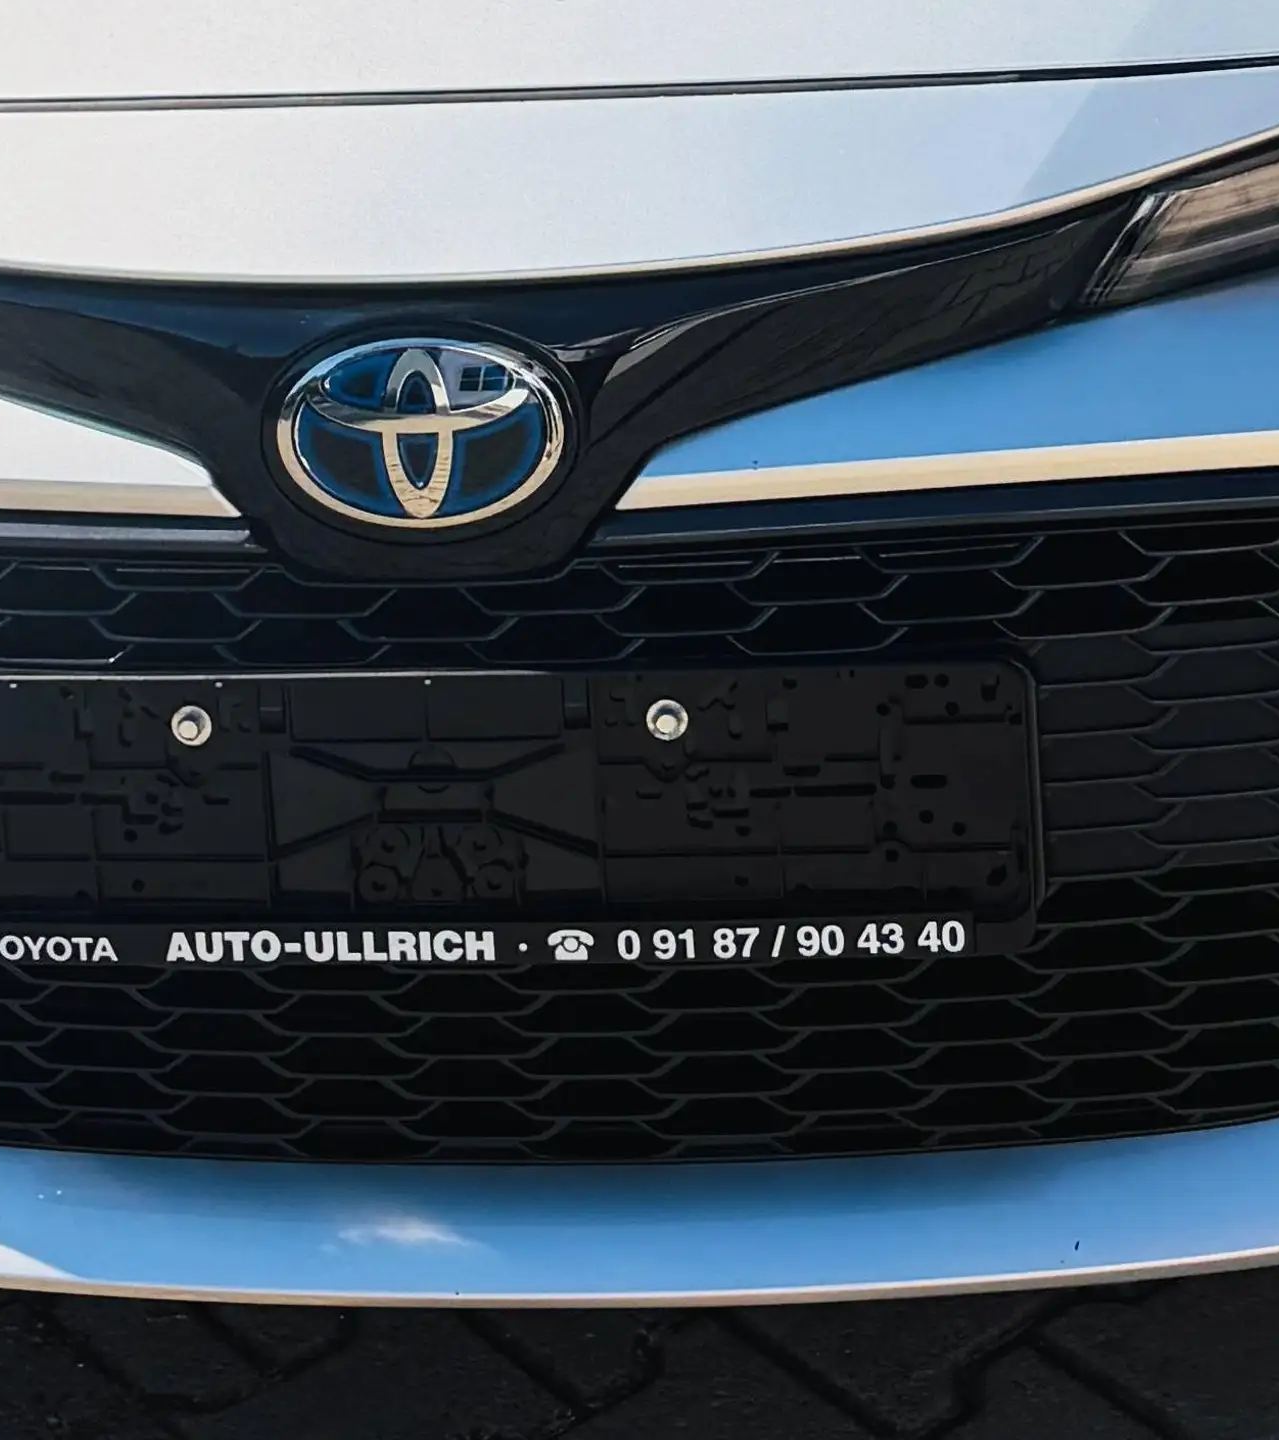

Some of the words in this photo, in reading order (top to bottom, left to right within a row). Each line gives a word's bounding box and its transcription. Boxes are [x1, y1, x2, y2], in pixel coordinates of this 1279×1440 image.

[166, 930, 496, 963] AUTO-ULLRICH
[617, 929, 641, 961] 0
[652, 928, 696, 960] 91
[857, 922, 905, 955] 43
[917, 920, 965, 953] 40
